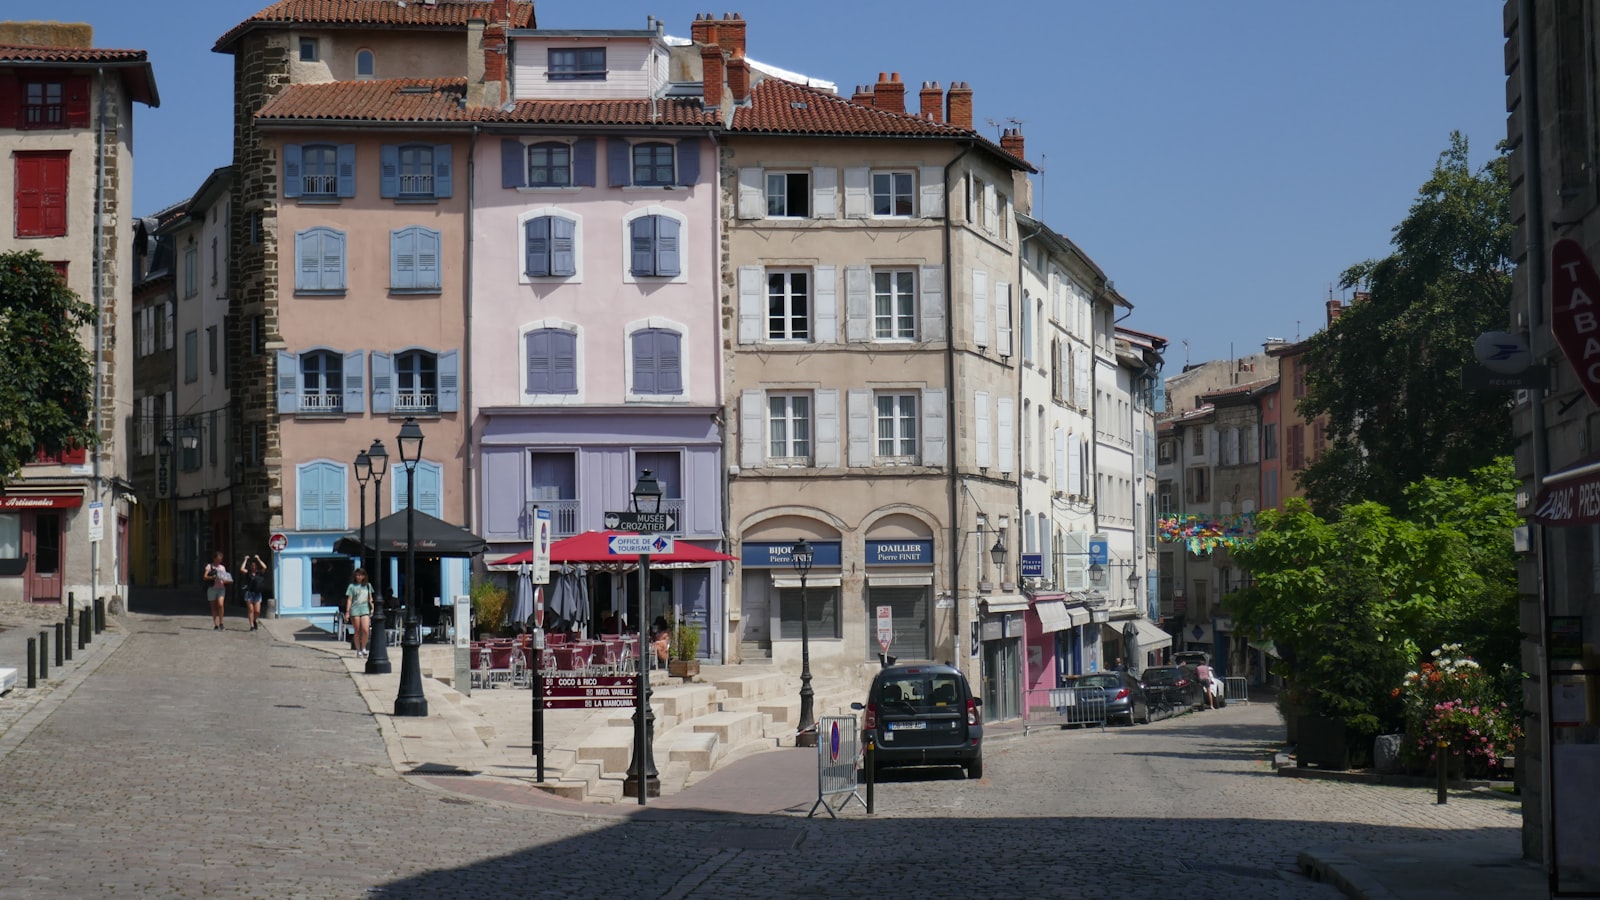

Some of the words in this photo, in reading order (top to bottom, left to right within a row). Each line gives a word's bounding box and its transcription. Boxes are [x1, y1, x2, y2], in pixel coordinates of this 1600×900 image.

[1561, 261, 1600, 384] TABAC
[5, 498, 54, 506] Artisanales
[1536, 487, 1574, 520] TABAC
[637, 513, 664, 522] MUSÉE
[621, 522, 664, 531] CROZATIER
[877, 544, 921, 553] JOAILLIER
[612, 688, 633, 696] VANILLE
[604, 699, 633, 707] MAMOUNIA
